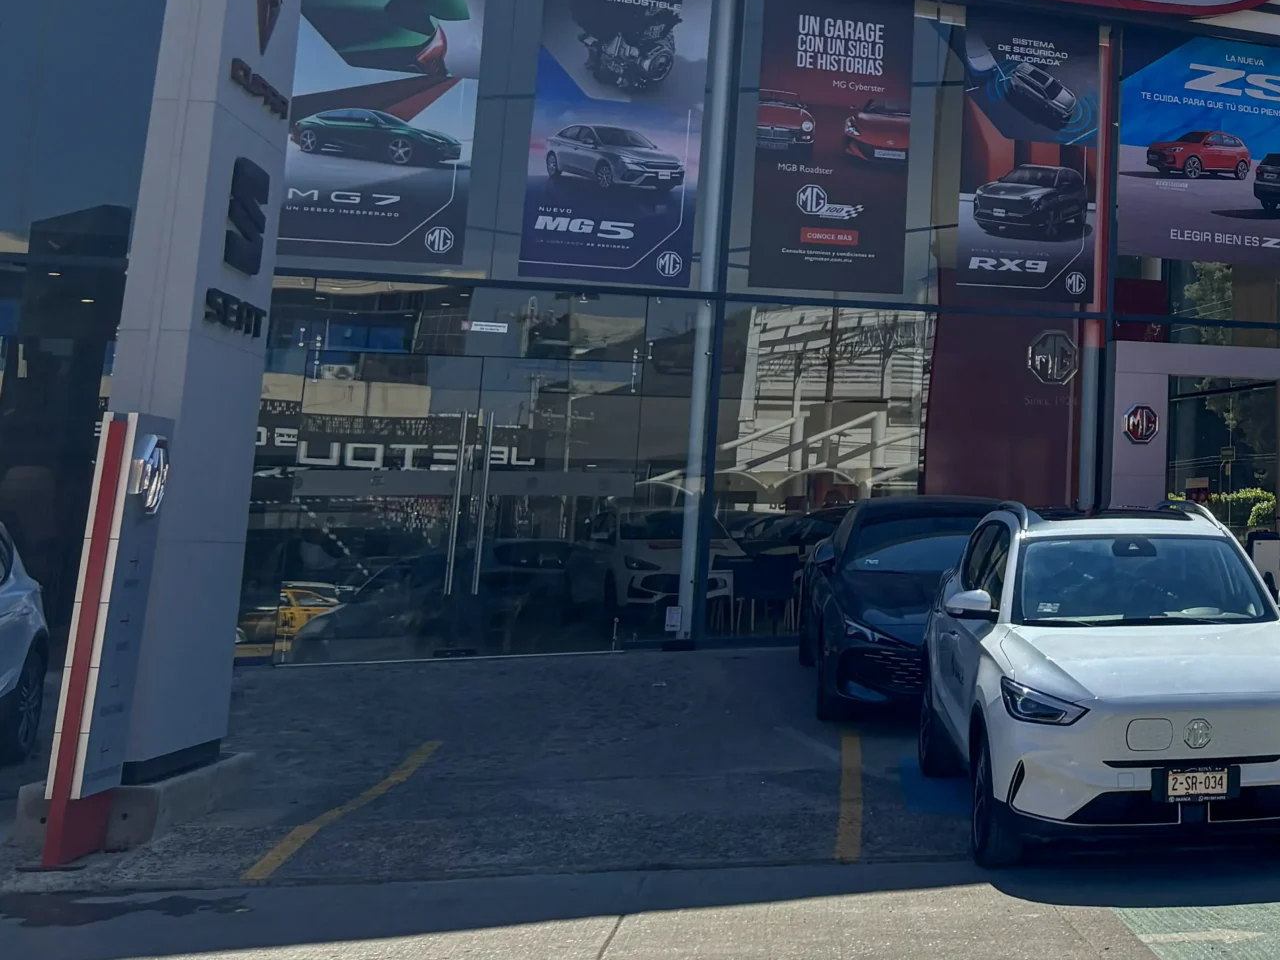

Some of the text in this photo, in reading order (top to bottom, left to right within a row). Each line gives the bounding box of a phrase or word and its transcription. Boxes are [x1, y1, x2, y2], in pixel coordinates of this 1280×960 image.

[798, 14, 885, 44] UN GARAGE
[797, 34, 884, 60] CON UN SIGLO
[1012, 37, 1056, 50] SISTEMA
[997, 44, 1069, 60] DE SEGURIDAD
[1005, 53, 1061, 67] MEJORADA
[796, 51, 884, 77] DE HISTORIAS
[1225, 54, 1265, 67] LA NUEVA
[832, 79, 886, 93] MG Cyberster
[1140, 91, 1152, 100] TE
[1153, 92, 1182, 105] CUIDA,
[1182, 96, 1206, 107] PARA
[1207, 99, 1224, 109] QUE
[1225, 101, 1237, 111] TÚ
[1237, 103, 1260, 115] SOLO
[777, 162, 834, 176] MGB Roadster
[338, 208, 400, 218] INESPERADO
[538, 205, 573, 214] NUEVO
[806, 232, 836, 241] CONOCE
[1169, 227, 1213, 243] ELEGIR
[1214, 232, 1242, 247] BIEN
[1244, 235, 1260, 247] ES
[968, 256, 1048, 274] RX9
[1067, 273, 1086, 293] MG
[1171, 775, 1224, 791] 2-SR-034
